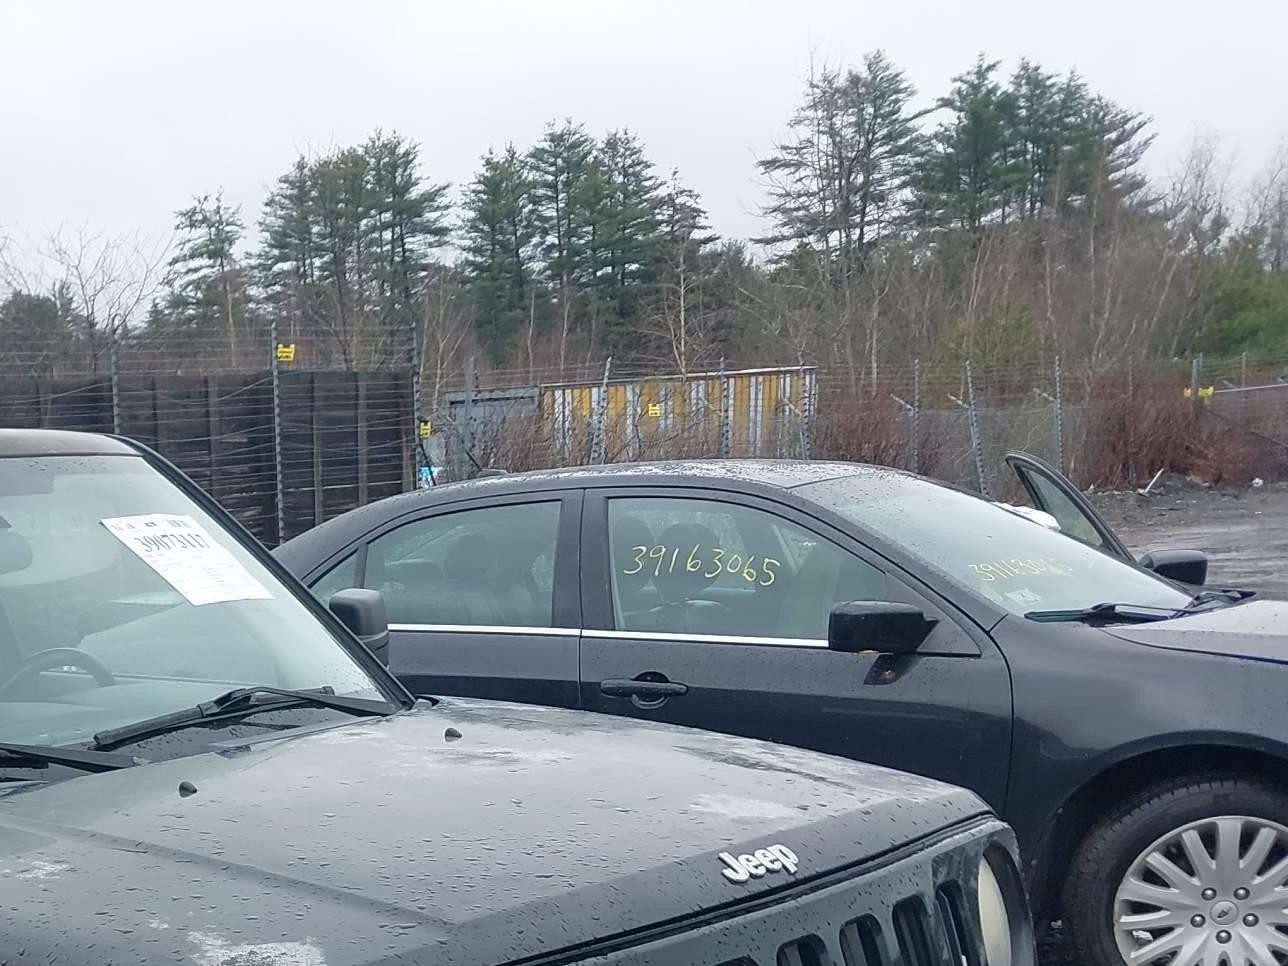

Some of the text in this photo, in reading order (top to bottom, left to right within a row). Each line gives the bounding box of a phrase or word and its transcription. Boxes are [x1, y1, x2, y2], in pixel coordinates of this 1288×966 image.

[134, 533, 210, 553] 39073117
[623, 543, 781, 586] 39163065
[718, 844, 800, 882] Jeep
